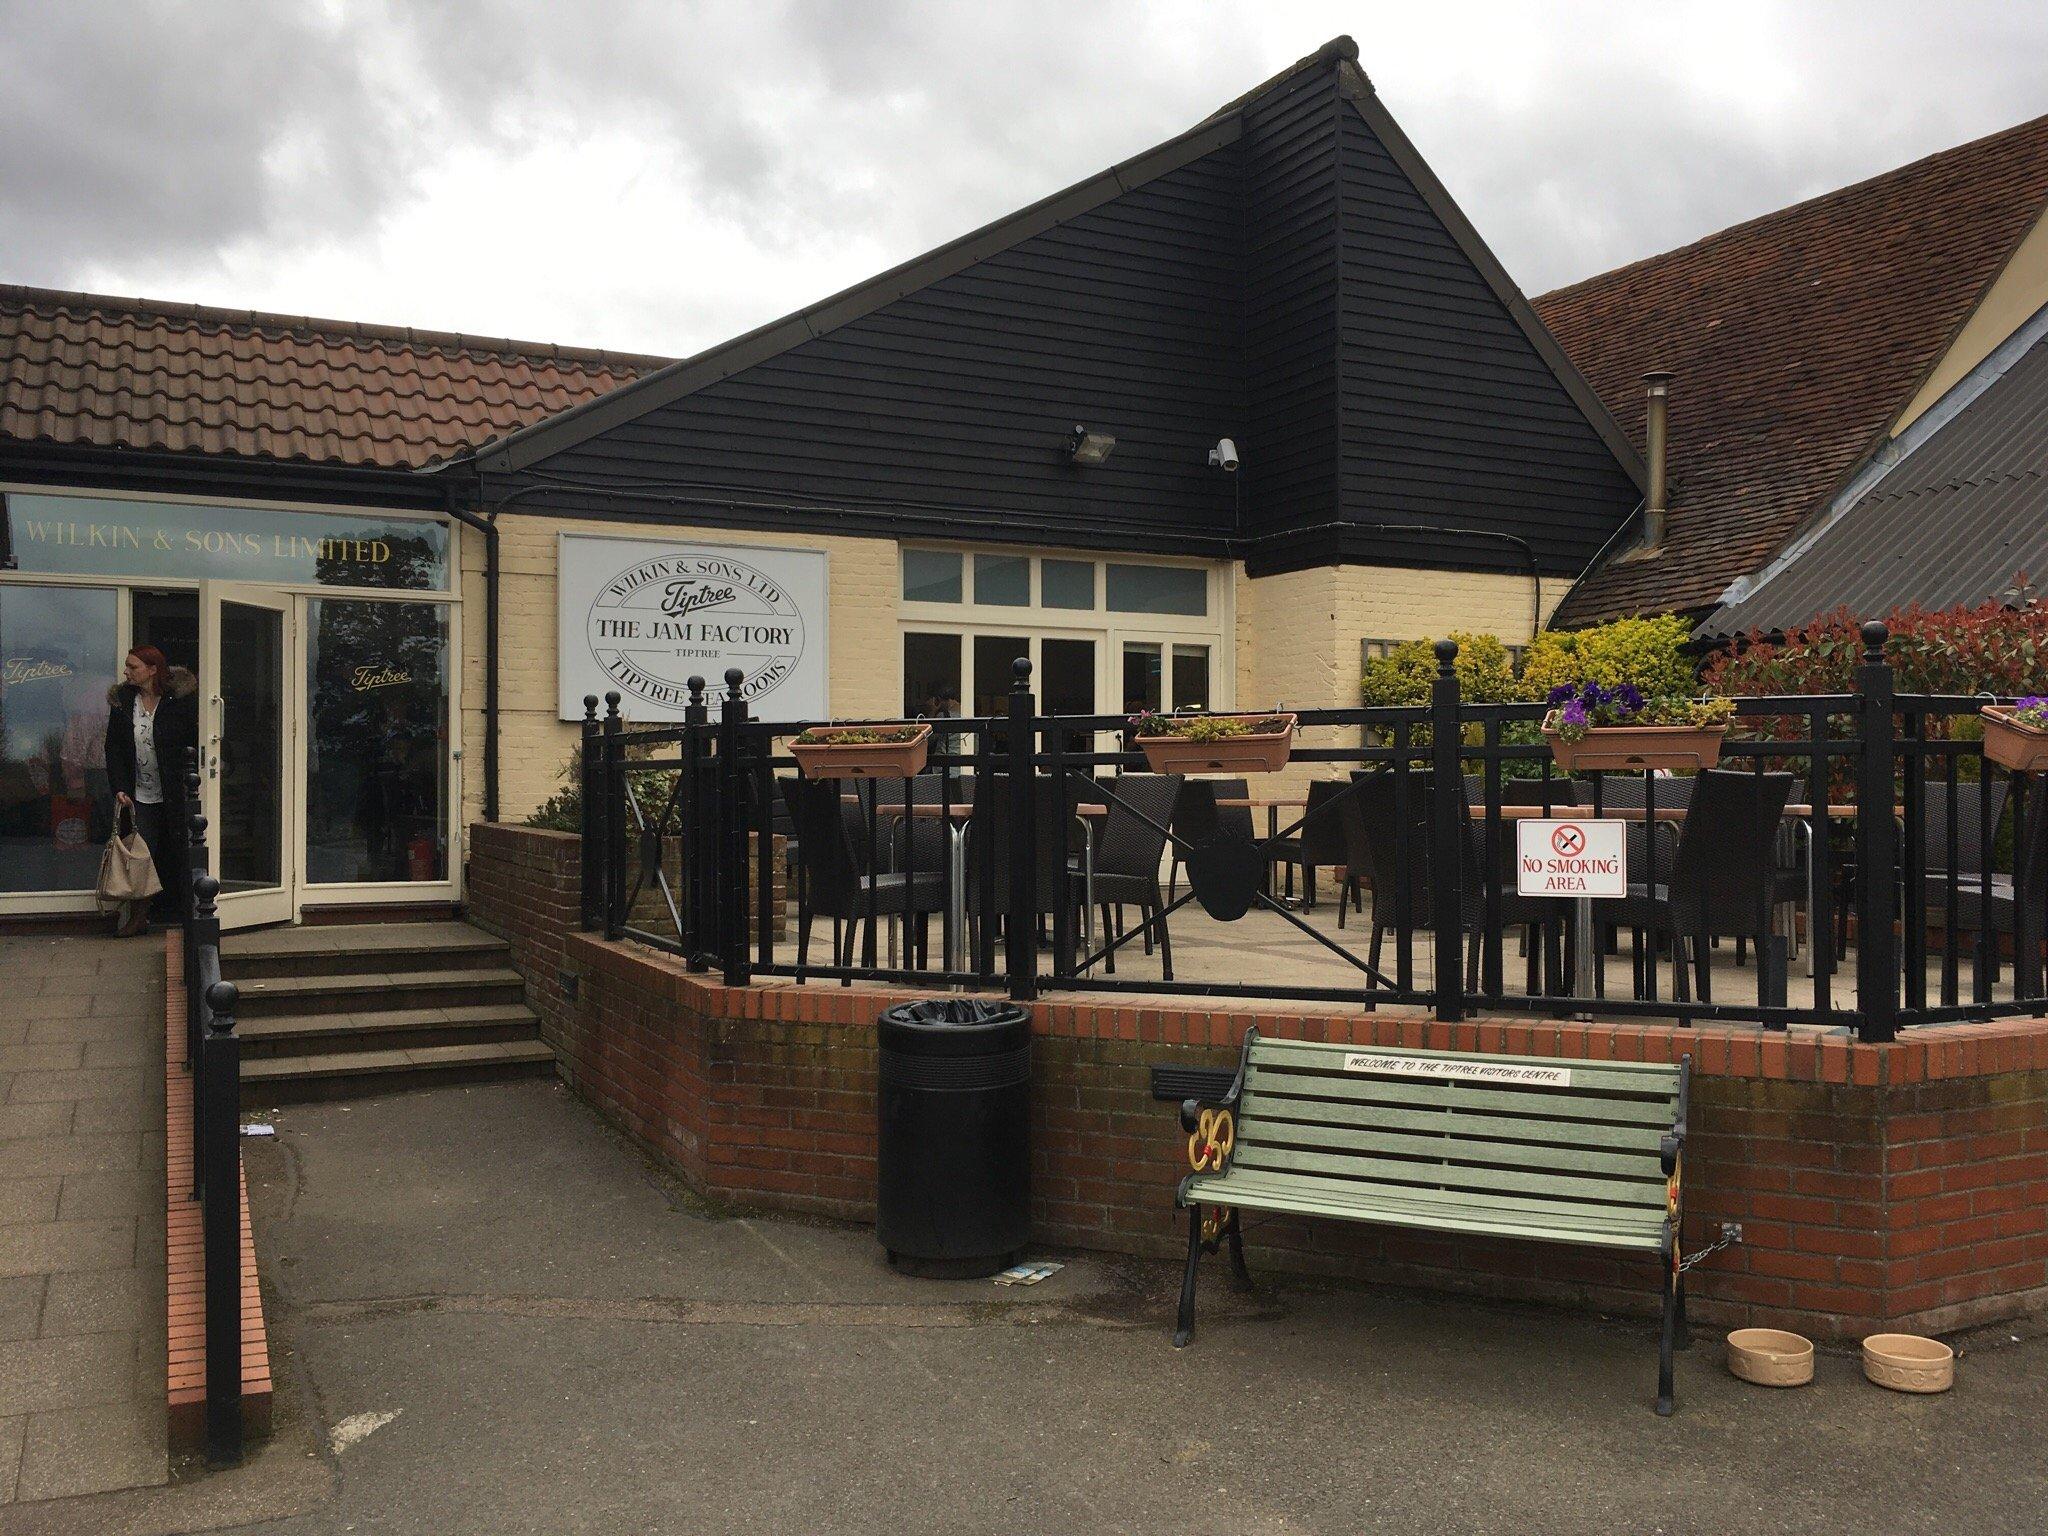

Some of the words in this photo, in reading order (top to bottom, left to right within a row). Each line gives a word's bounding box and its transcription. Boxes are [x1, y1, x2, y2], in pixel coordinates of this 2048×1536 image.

[27, 520, 142, 549] WILKIN
[153, 528, 174, 551] &
[185, 529, 262, 556] SONS
[273, 534, 391, 563] LIMITED
[610, 562, 670, 597] WILKIN
[676, 560, 691, 574] &
[696, 561, 743, 581] SONS
[747, 574, 781, 604] LTD
[661, 580, 736, 618] Tiptree
[596, 619, 641, 638] THE
[646, 622, 692, 641] JAM
[700, 624, 794, 645] FACTORY
[675, 649, 721, 659] TIPTREE
[3, 656, 73, 684] Tiptree
[351, 664, 412, 692] Tiptree
[609, 656, 685, 704] TIPTREE
[702, 691, 725, 706] EA
[739, 660, 787, 699] OOMS
[1522, 858, 1543, 873] NO
[1547, 859, 1619, 874] SMOKING
[1545, 876, 1586, 891] AREA
[1350, 1057, 1400, 1070] WELCOME
[1402, 1061, 1416, 1071] TO
[1418, 1062, 1441, 1072] THE
[1441, 1063, 1480, 1075] TIPTREE
[1480, 1067, 1521, 1078] VISITORS
[1521, 1070, 1562, 1081] CENTRE
